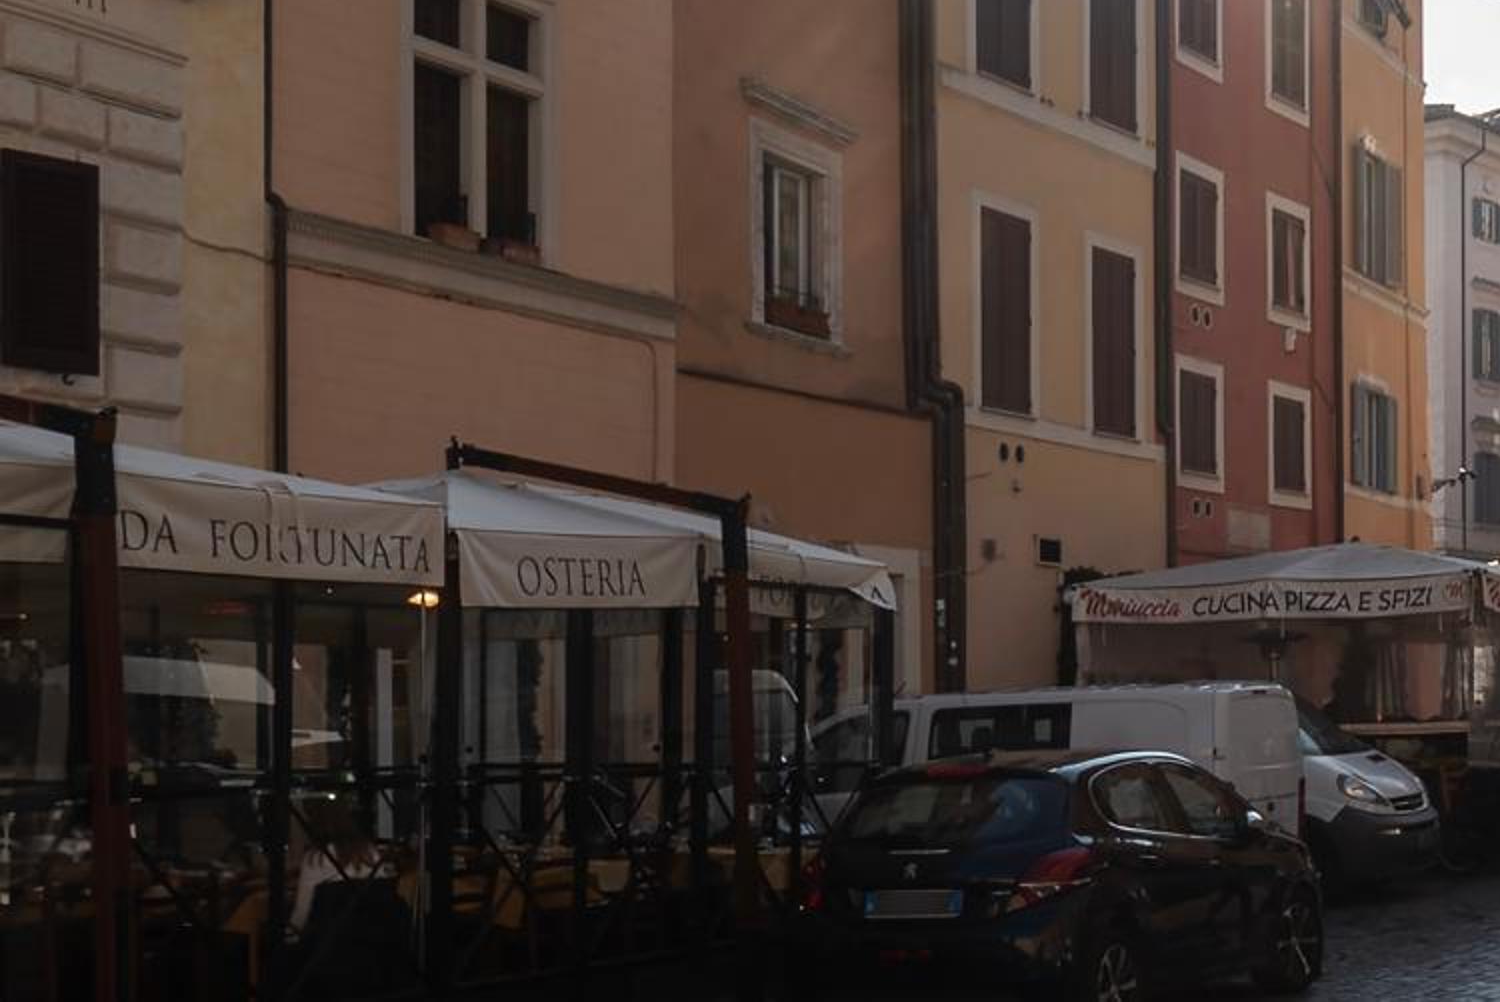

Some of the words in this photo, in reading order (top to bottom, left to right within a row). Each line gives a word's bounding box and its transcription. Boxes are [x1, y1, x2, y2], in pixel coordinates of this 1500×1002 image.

[119, 509, 177, 554] DA
[517, 555, 646, 597] OSTERIA
[1192, 590, 1279, 615] CUCINA
[1285, 590, 1350, 612] PIZZA
[1358, 591, 1370, 611] E
[1378, 586, 1432, 611] SFIZI
